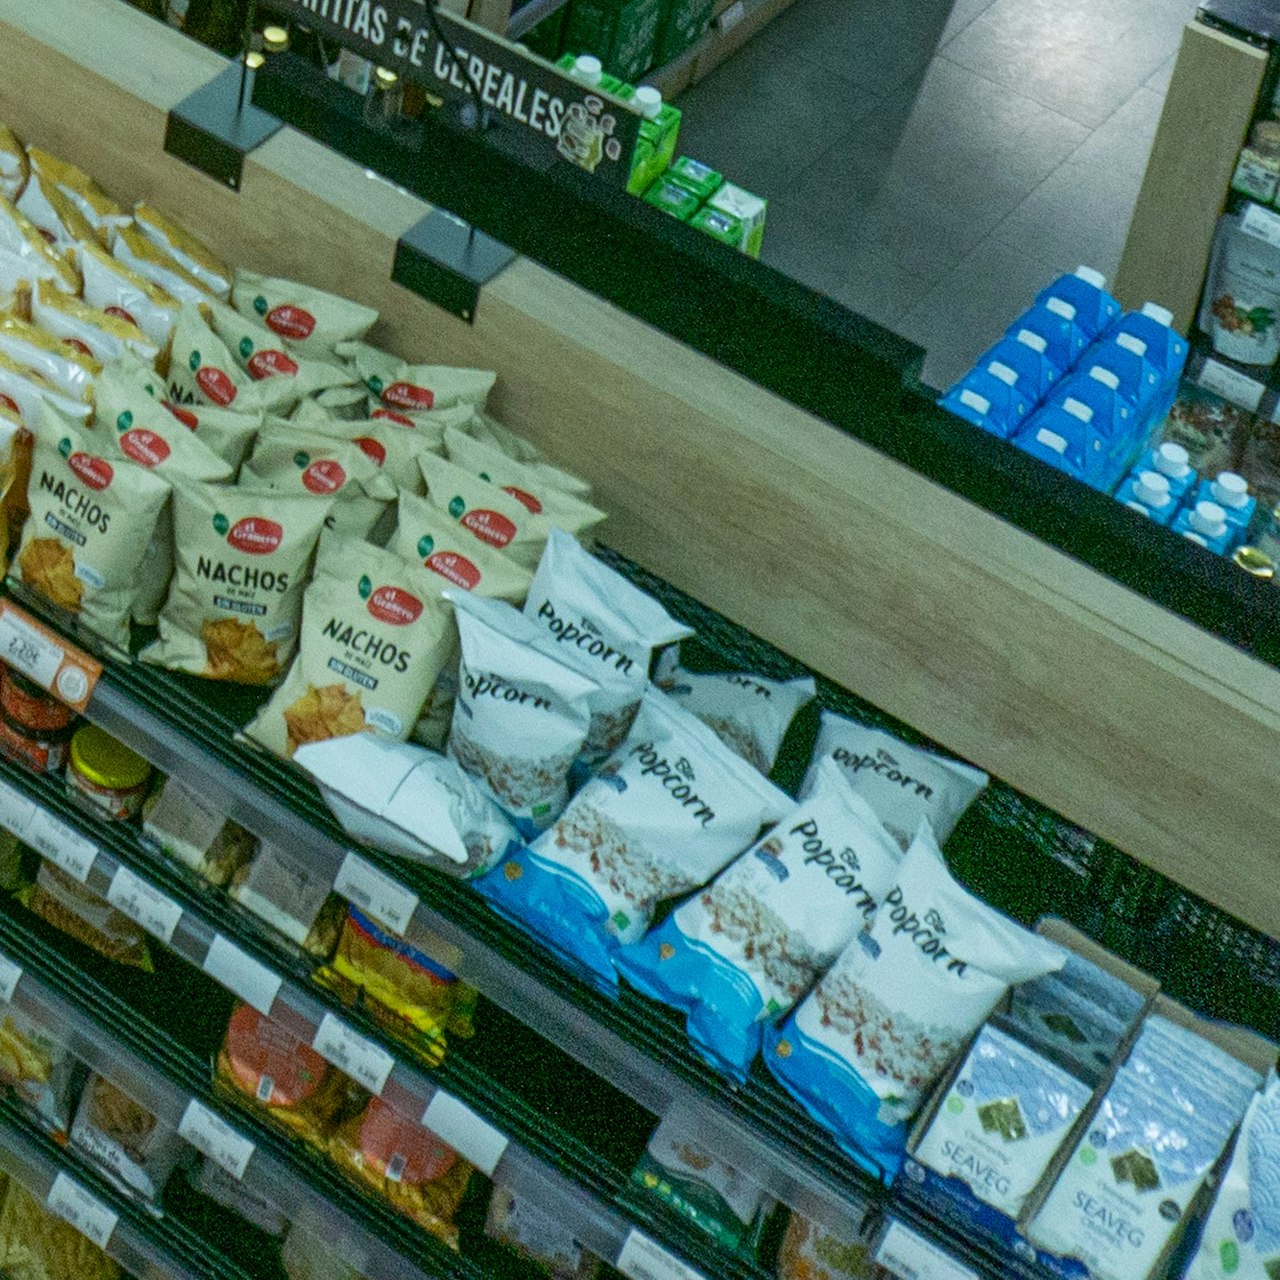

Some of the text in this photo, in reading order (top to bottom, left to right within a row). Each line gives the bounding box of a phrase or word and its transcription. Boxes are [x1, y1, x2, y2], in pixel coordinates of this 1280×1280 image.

[393, 16, 426, 67] DE
[434, 41, 565, 138] CEREALES
[40, 471, 110, 534] NACHOS
[233, 528, 279, 546] Granero
[197, 556, 289, 592] NACHOS
[322, 618, 411, 673] NACHOS
[538, 598, 635, 678] Popcorn
[628, 740, 717, 831] Popcorn
[790, 817, 878, 921] Popcorn
[883, 885, 969, 978] Popcorn
[940, 1143, 1012, 1195] SEAVEG
[1072, 1191, 1144, 1248] SEAVEG
